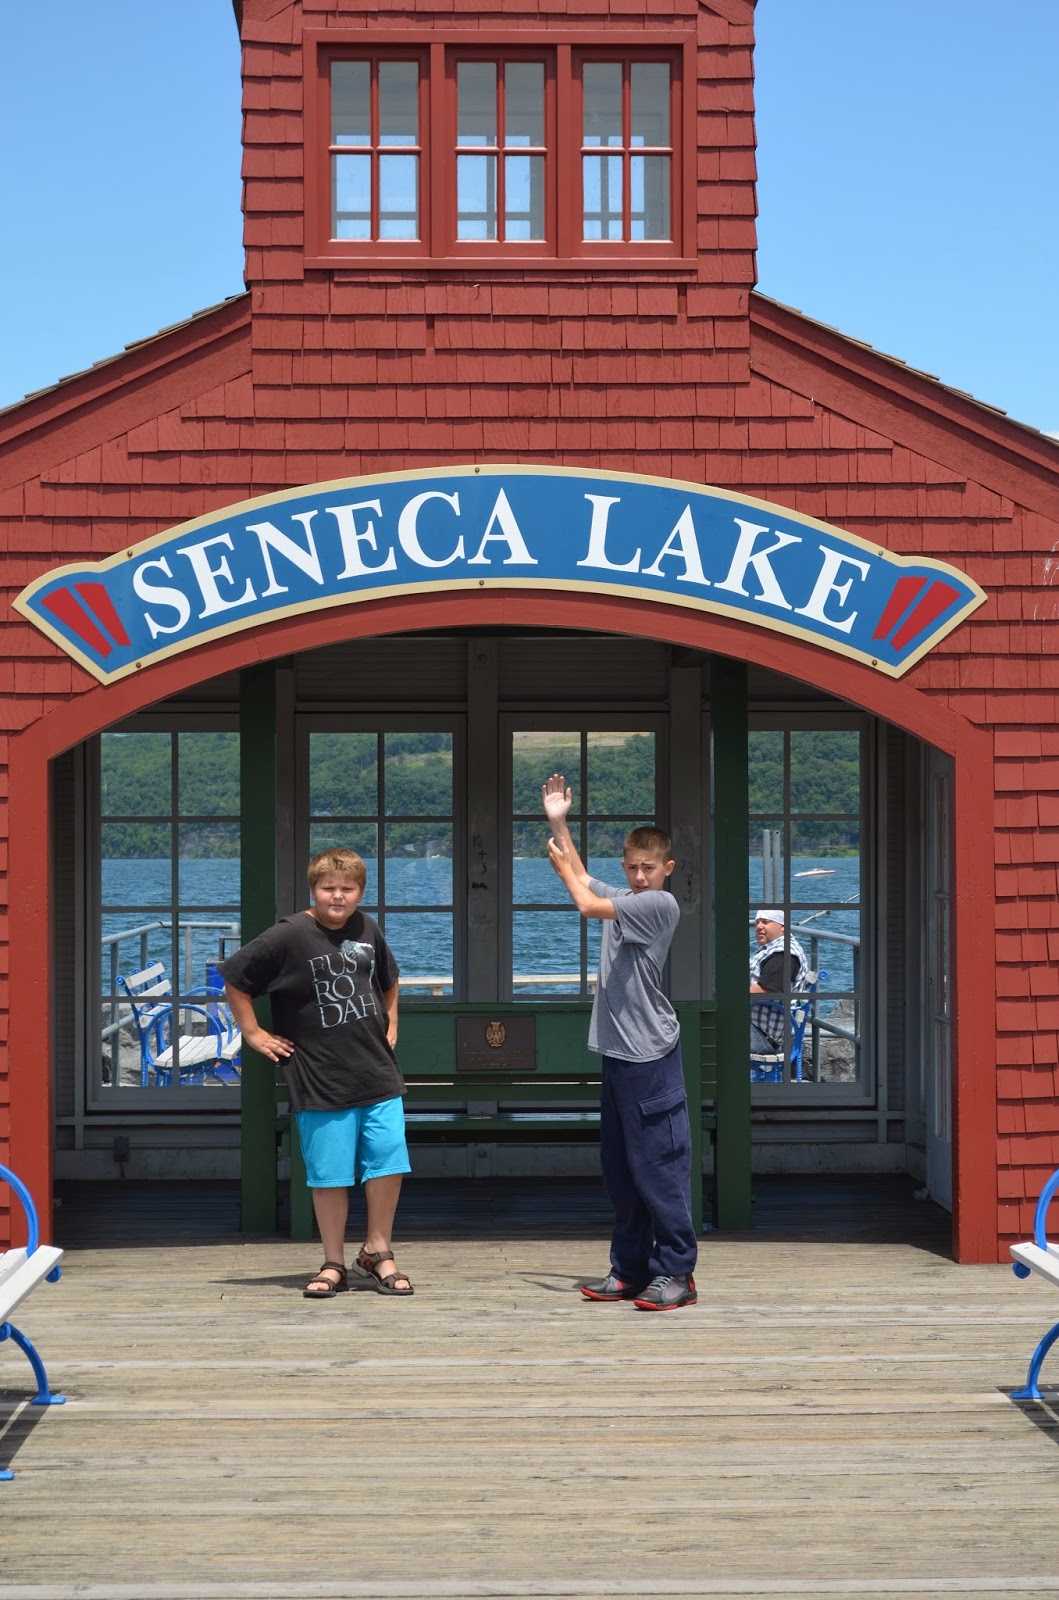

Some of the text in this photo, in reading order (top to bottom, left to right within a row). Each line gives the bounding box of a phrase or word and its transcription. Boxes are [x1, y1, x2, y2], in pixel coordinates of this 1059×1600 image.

[131, 487, 871, 640] SENECA LAKE
[308, 952, 358, 981] FUS
[313, 975, 356, 1005] RO
[318, 993, 378, 1029] DAH
